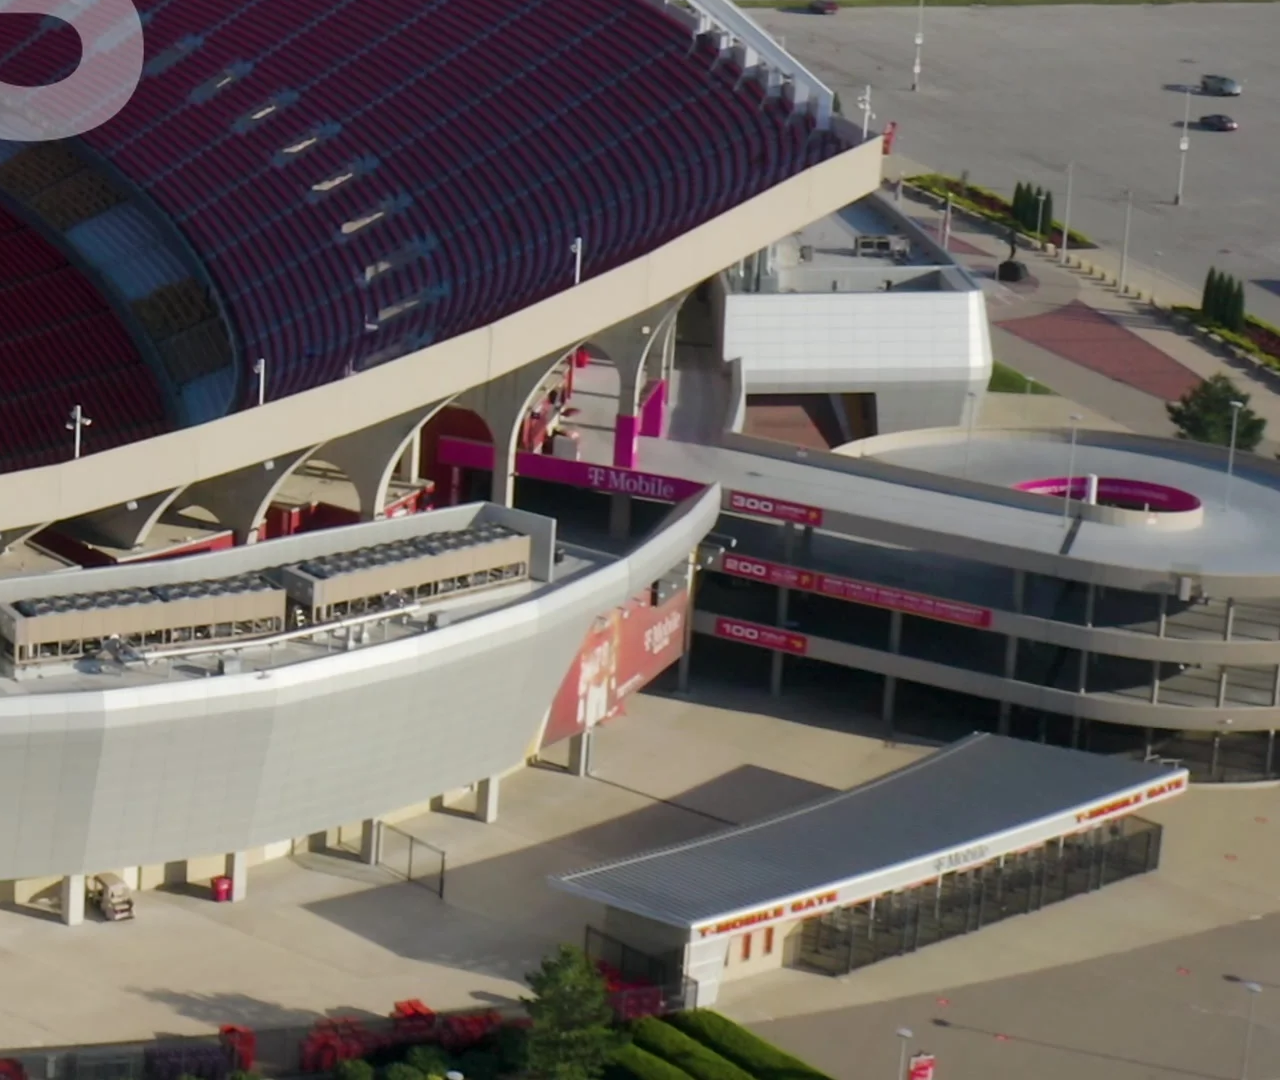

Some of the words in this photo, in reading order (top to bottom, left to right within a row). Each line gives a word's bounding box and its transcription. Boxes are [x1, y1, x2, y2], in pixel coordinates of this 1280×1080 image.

[608, 470, 674, 498] Mobile
[732, 495, 774, 513] 300
[724, 558, 767, 577] 200
[721, 622, 760, 641] 100
